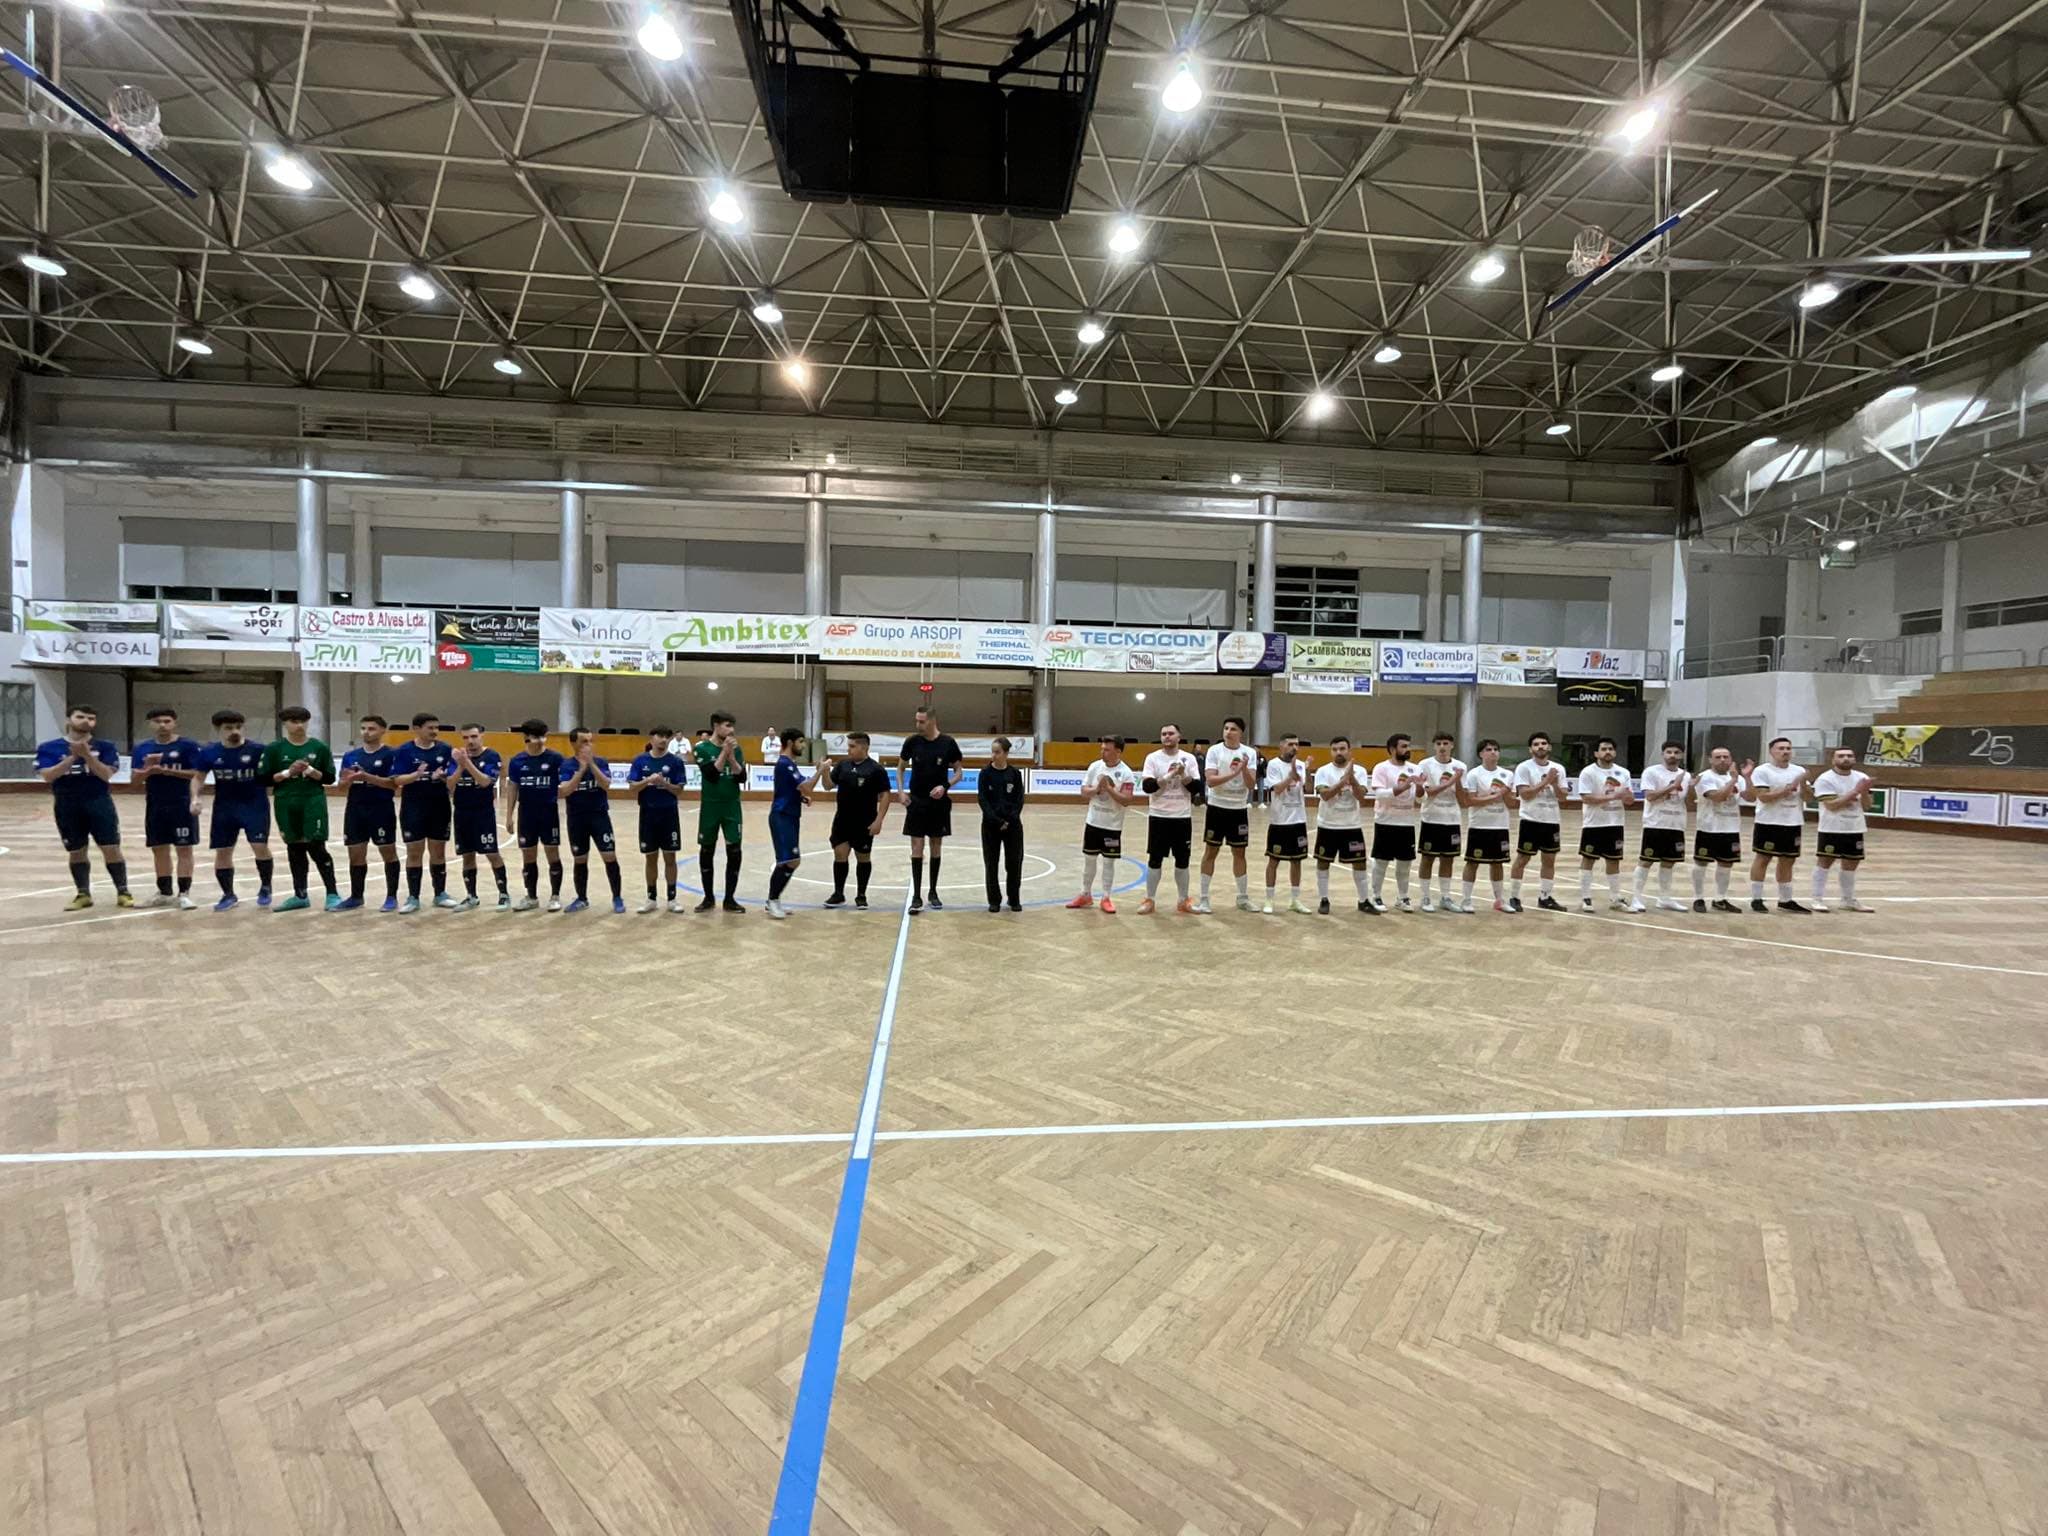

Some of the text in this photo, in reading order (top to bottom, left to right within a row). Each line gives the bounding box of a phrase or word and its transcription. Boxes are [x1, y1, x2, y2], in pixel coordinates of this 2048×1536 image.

[244, 619, 283, 628] SPORT
[332, 610, 427, 627] Castro & Alves Lda.
[663, 617, 809, 650] Ambitex
[826, 624, 857, 636] ASP
[864, 624, 961, 640] Grupo ARSOPI
[985, 628, 1025, 636] ARSOPI
[1045, 631, 1072, 642] ASP
[52, 640, 152, 656] LACTOGAL
[979, 640, 1031, 649] THERMAL
[305, 644, 357, 662] JPM
[370, 646, 422, 664] JPM
[901, 650, 915, 658] DE
[918, 650, 961, 659] CAMBRA
[976, 652, 1034, 661] TECNOCON
[1307, 646, 1372, 657] CAMBRASTOCKS
[1407, 649, 1474, 661] reclacambra
[1313, 675, 1352, 683] AMARAL
[1969, 728, 2014, 765] 25
[176, 827, 189, 837] 10
[378, 827, 385, 836] 6
[671, 831, 678, 840] 9
